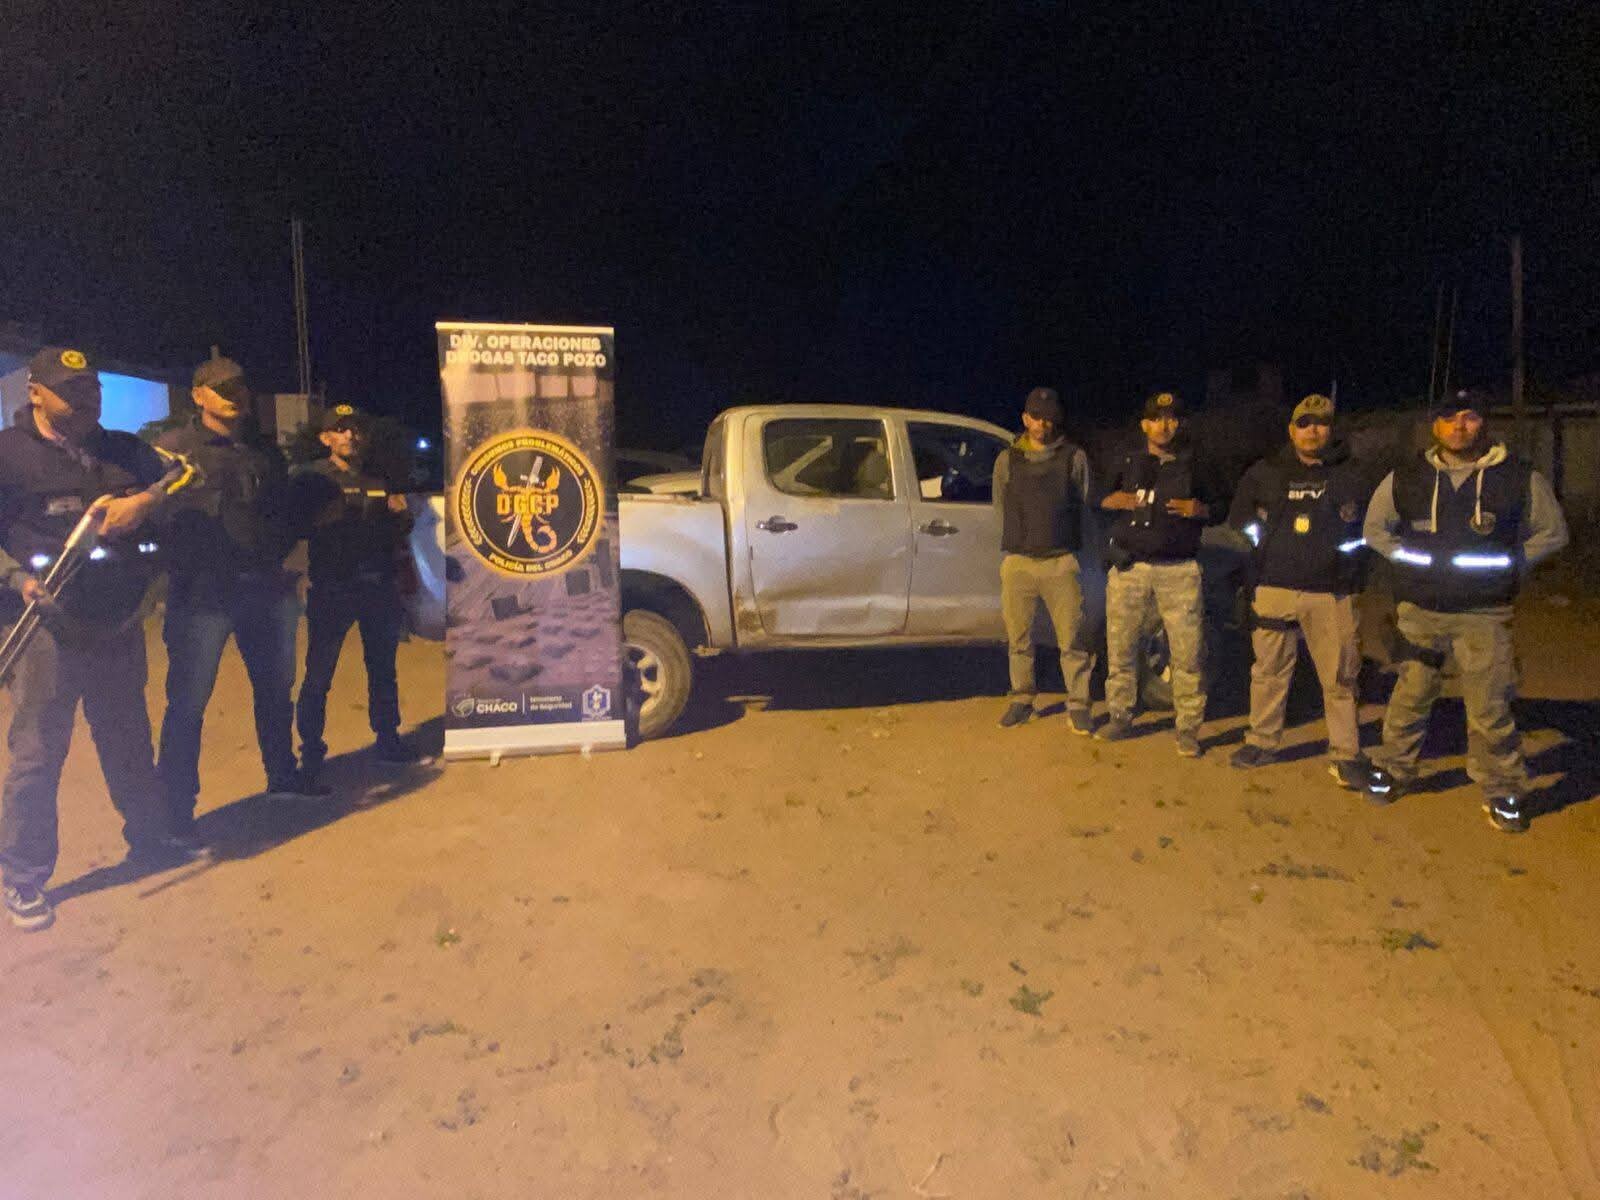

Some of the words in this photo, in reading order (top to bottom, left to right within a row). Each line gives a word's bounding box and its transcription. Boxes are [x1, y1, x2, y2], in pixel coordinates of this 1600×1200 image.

[487, 335, 601, 351] OPERACIONES
[519, 351, 559, 367] TACO
[563, 353, 607, 368] POZO
[476, 701, 518, 714] CHACO
